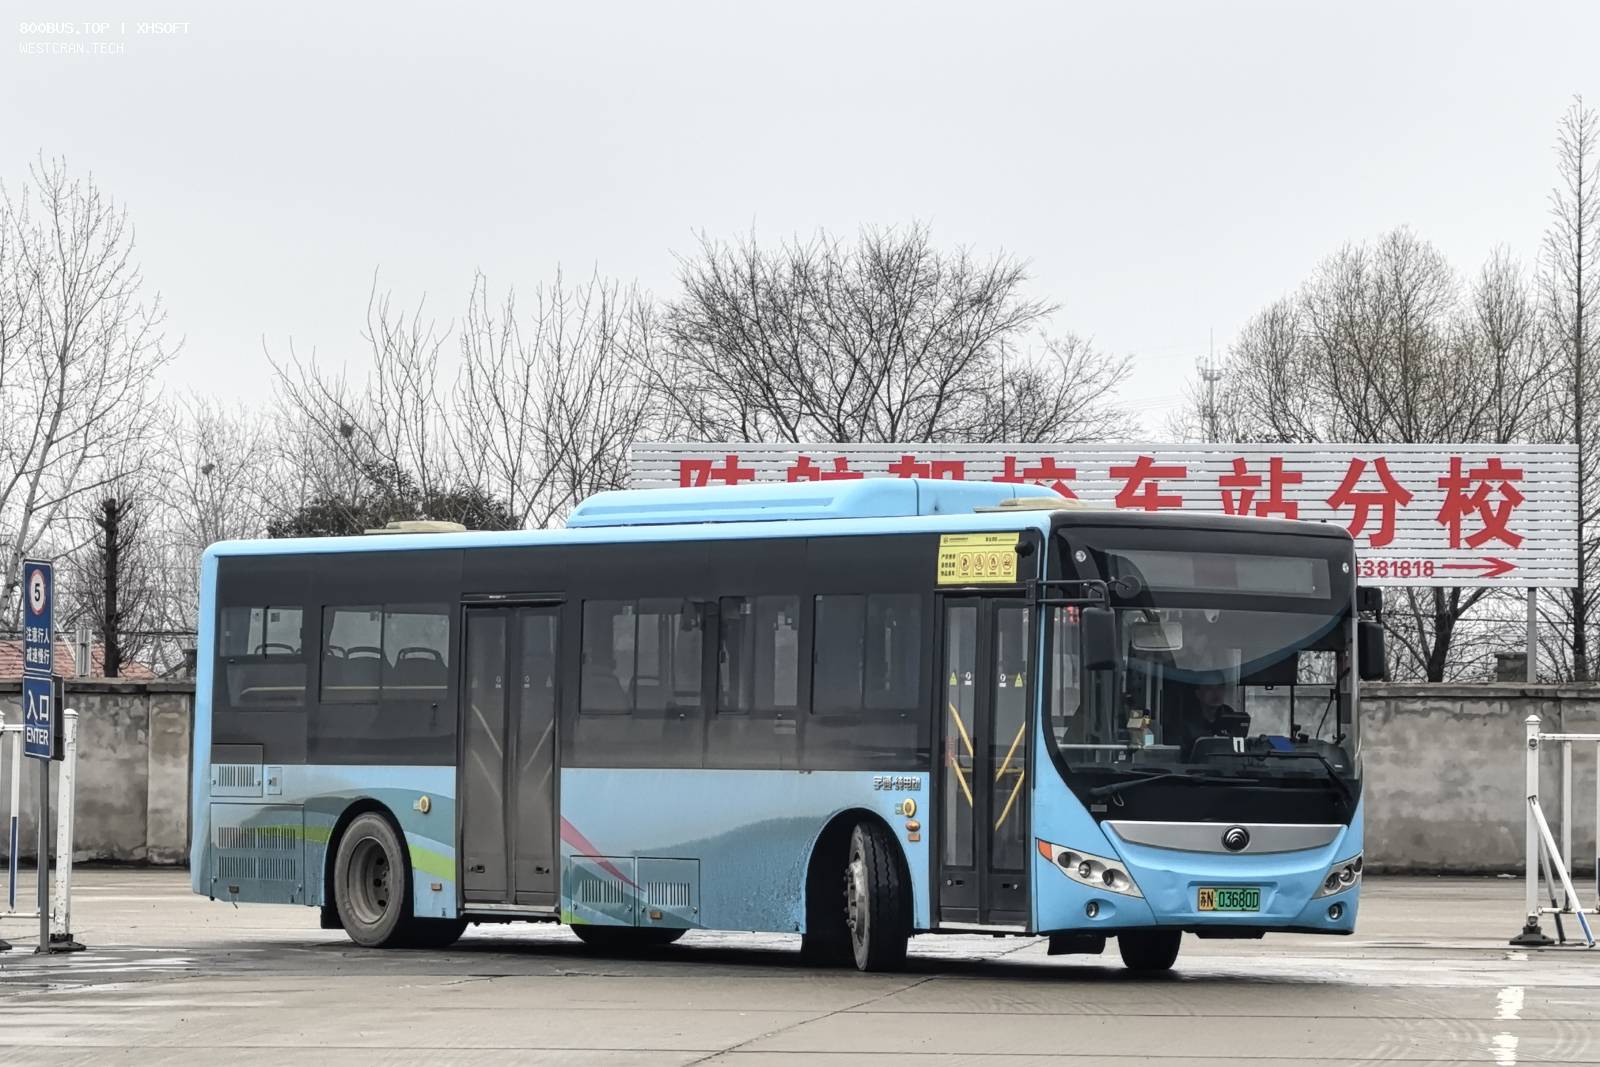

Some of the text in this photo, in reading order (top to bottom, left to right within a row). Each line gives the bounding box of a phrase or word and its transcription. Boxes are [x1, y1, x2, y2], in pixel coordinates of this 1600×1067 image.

[680, 455, 1526, 549] 车站分校
[34, 583, 41, 602] 5
[26, 626, 50, 644] 注意行人
[26, 646, 50, 665] 减速慢行
[26, 690, 49, 722] 入口
[26, 727, 49, 746] ENTER
